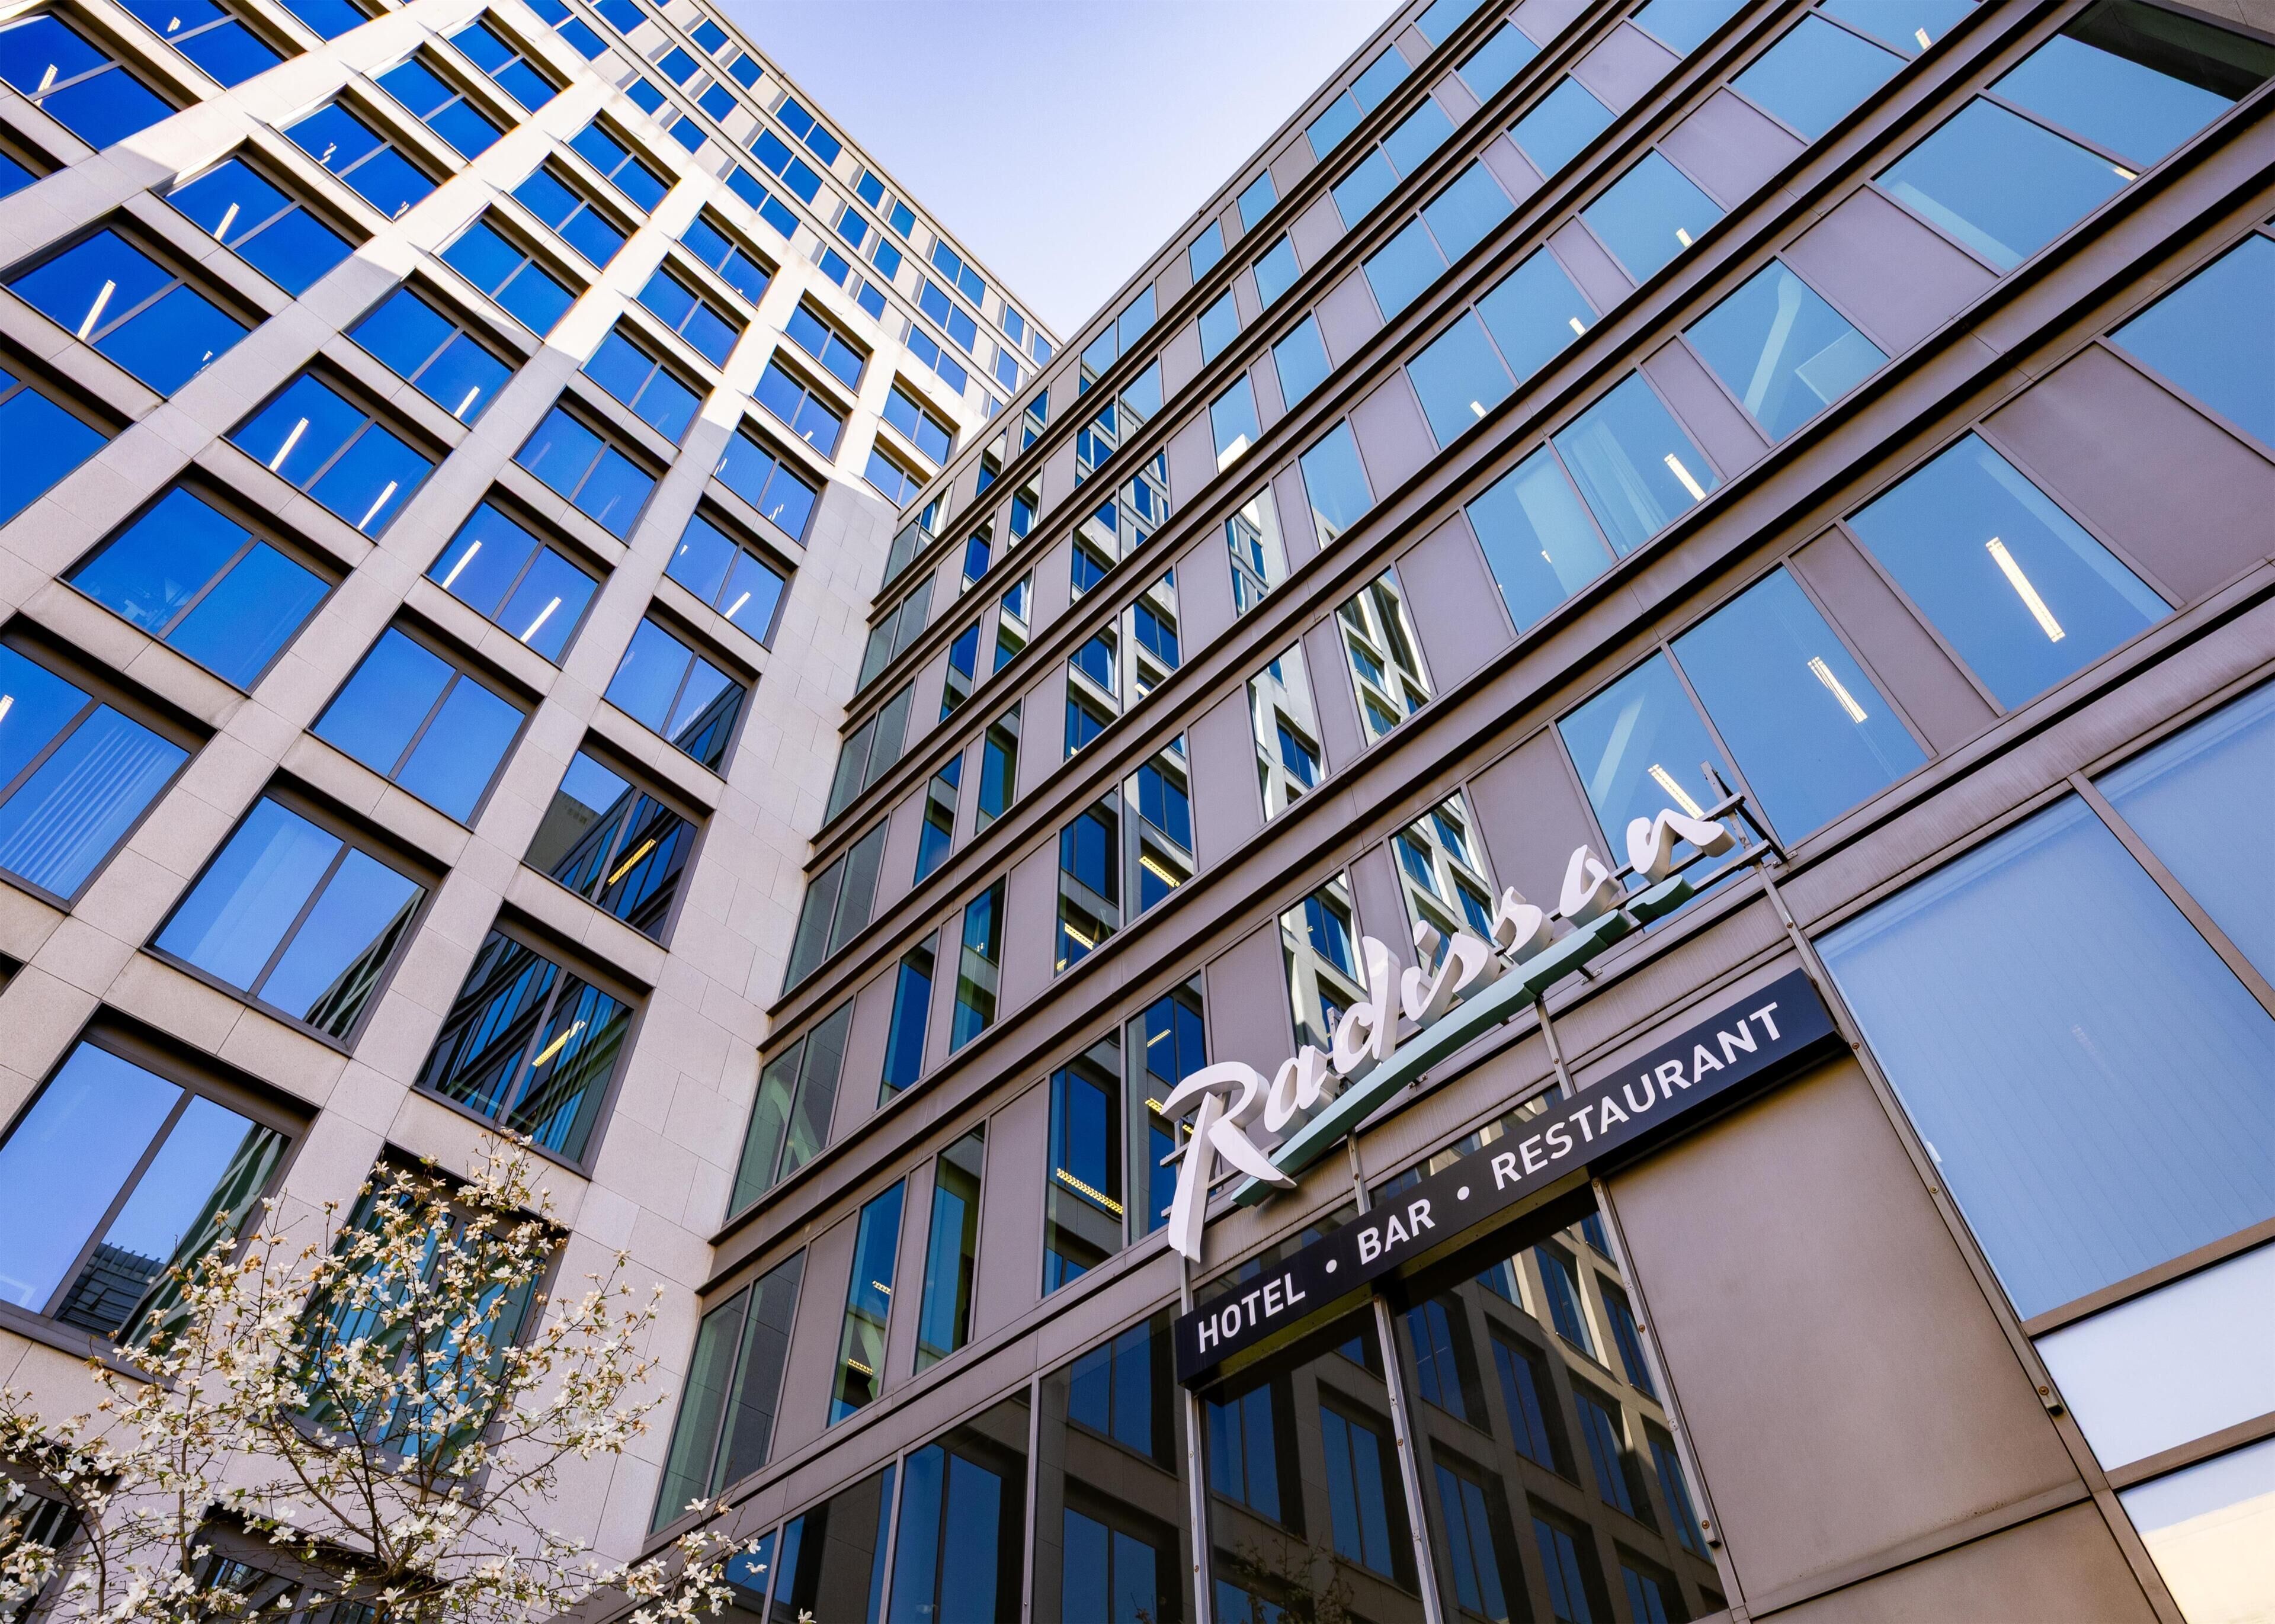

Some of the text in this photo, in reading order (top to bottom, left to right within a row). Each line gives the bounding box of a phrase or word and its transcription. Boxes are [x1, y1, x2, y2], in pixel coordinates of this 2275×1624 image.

[1159, 808, 1737, 1263] Radisson
[1197, 1001, 1781, 1354] HOTEL BAR RESTAURANT
